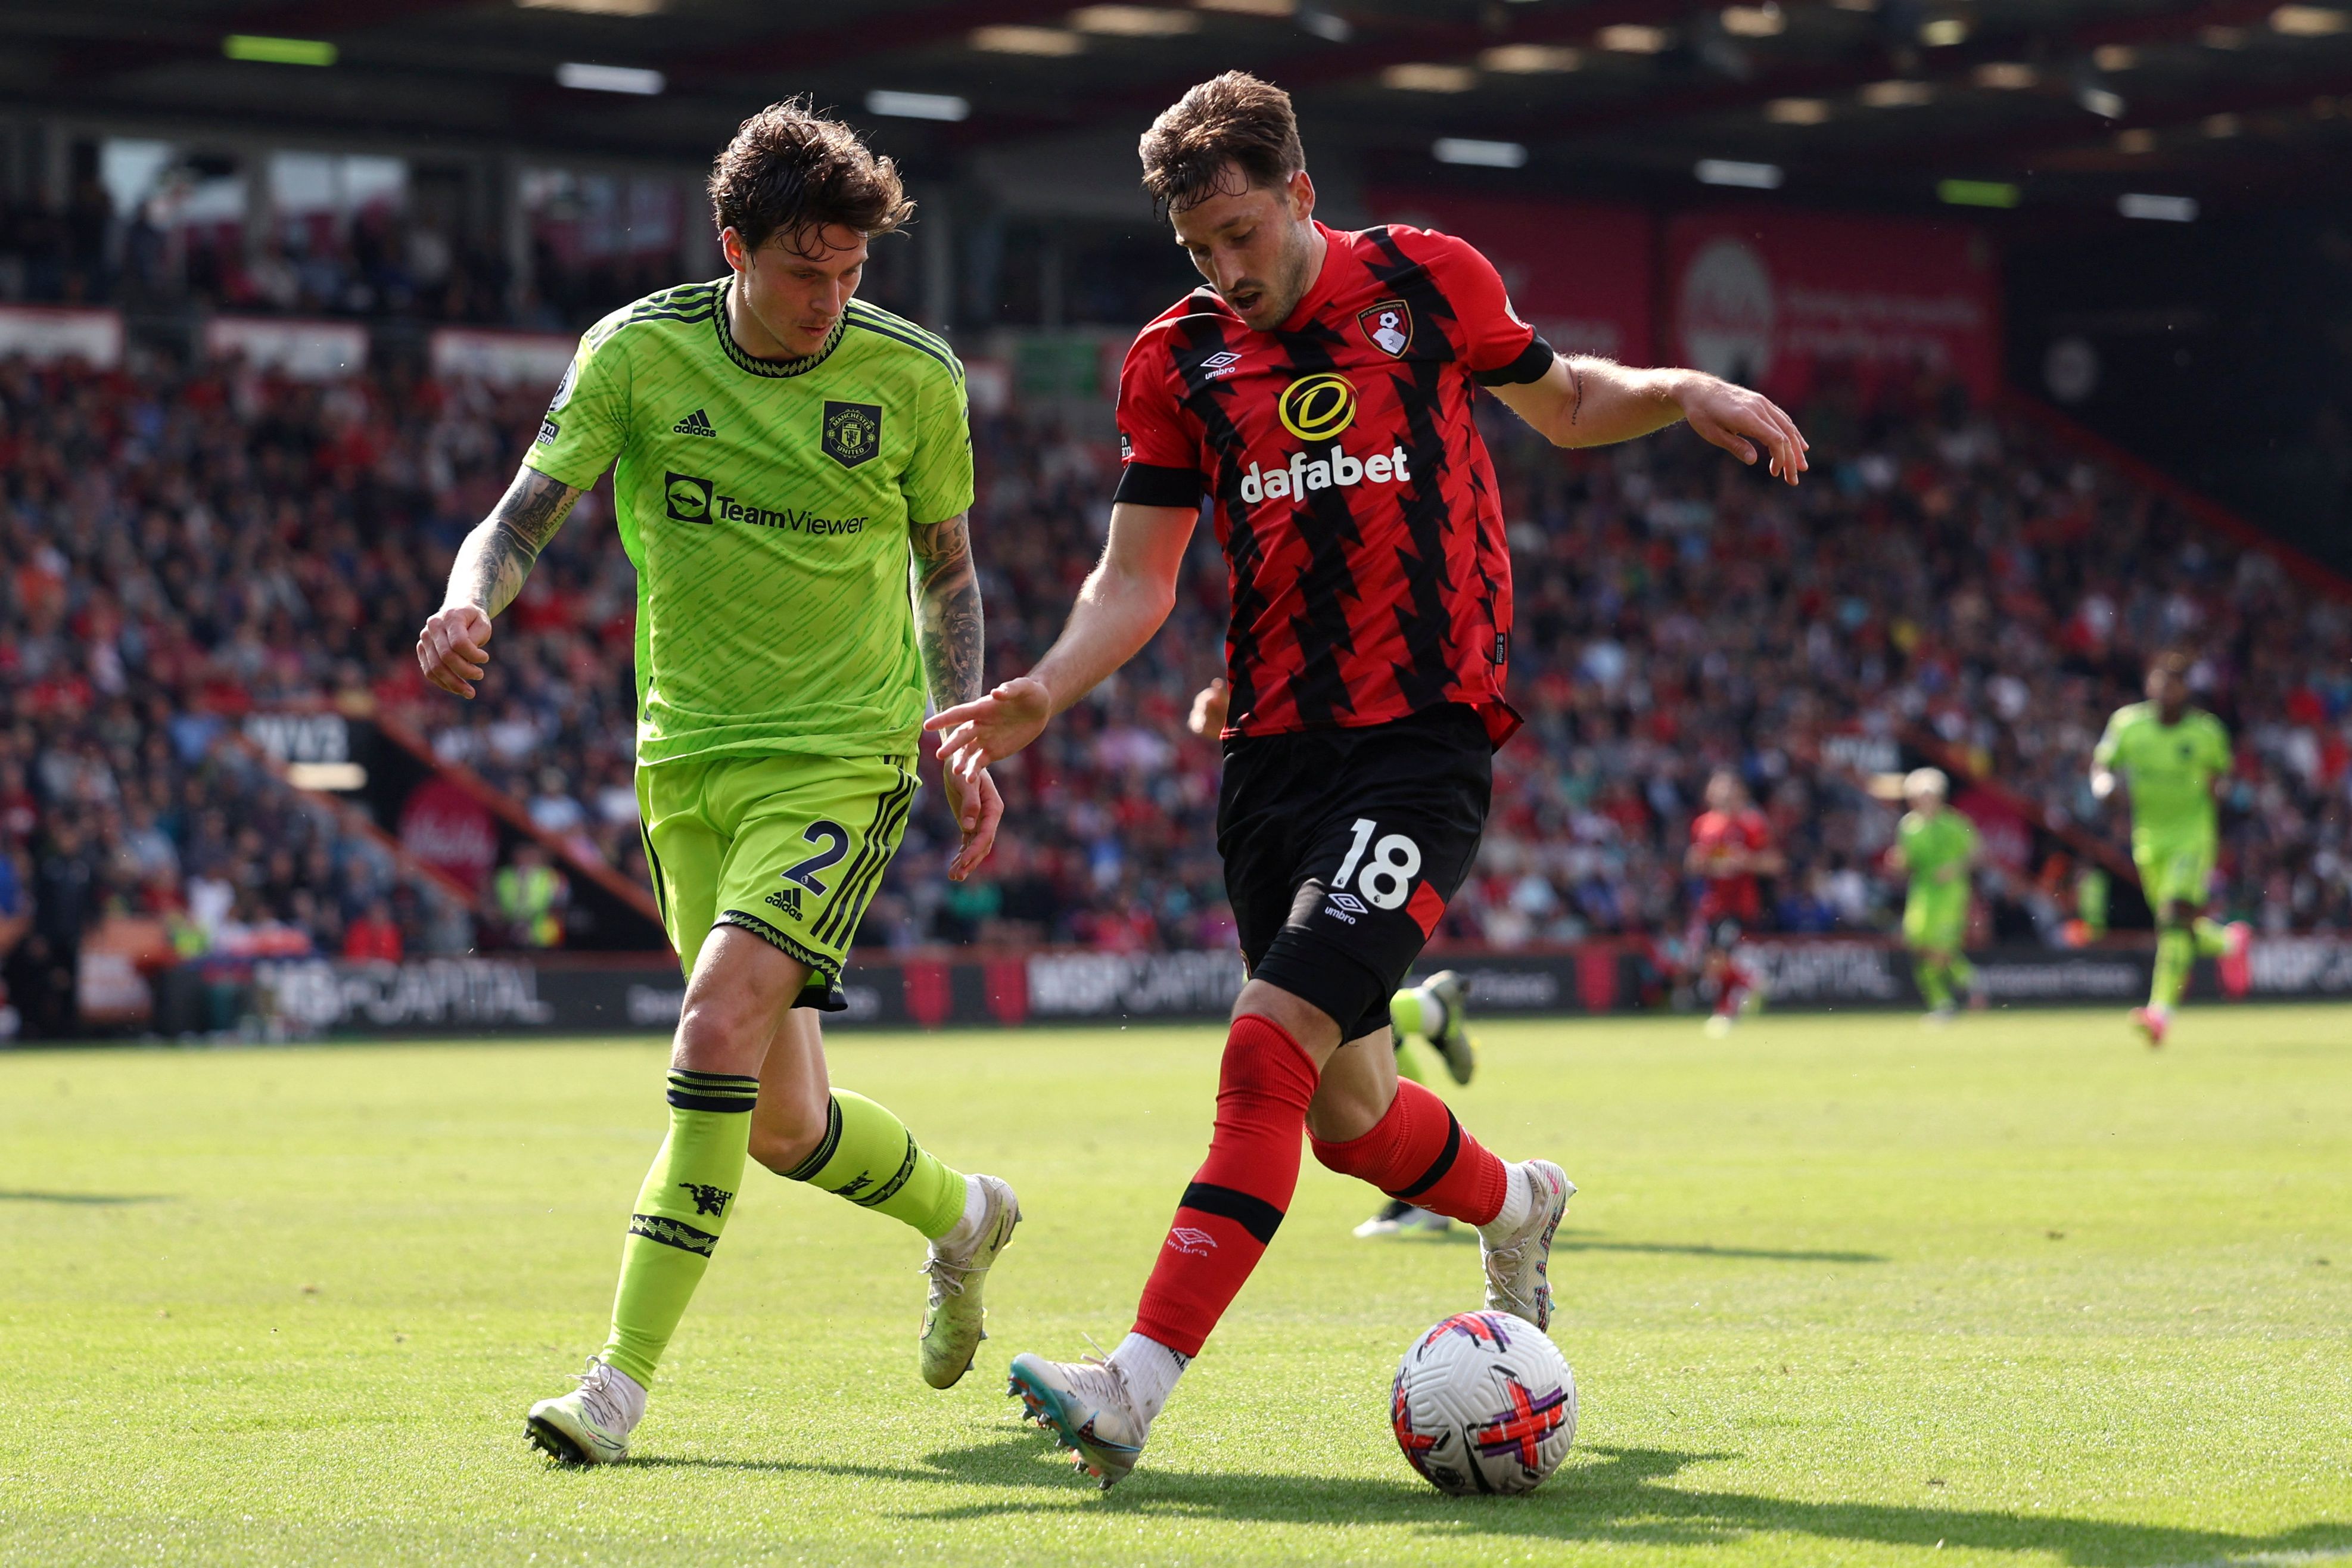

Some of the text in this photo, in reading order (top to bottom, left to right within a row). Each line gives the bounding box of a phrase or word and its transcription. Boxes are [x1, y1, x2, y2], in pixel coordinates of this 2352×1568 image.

[1205, 366, 1236, 380] umbro
[673, 424, 717, 437] adidas
[832, 412, 872, 430] MANCHESTER
[836, 445, 865, 455] UNITED
[1240, 444, 1411, 503] dafabet
[716, 495, 869, 535] TeamViewer
[779, 819, 850, 898] 2
[1331, 818, 1421, 910] 18
[764, 895, 804, 922] adidas
[1324, 906, 1356, 925] umbro
[1167, 1239, 1208, 1257] umbro
